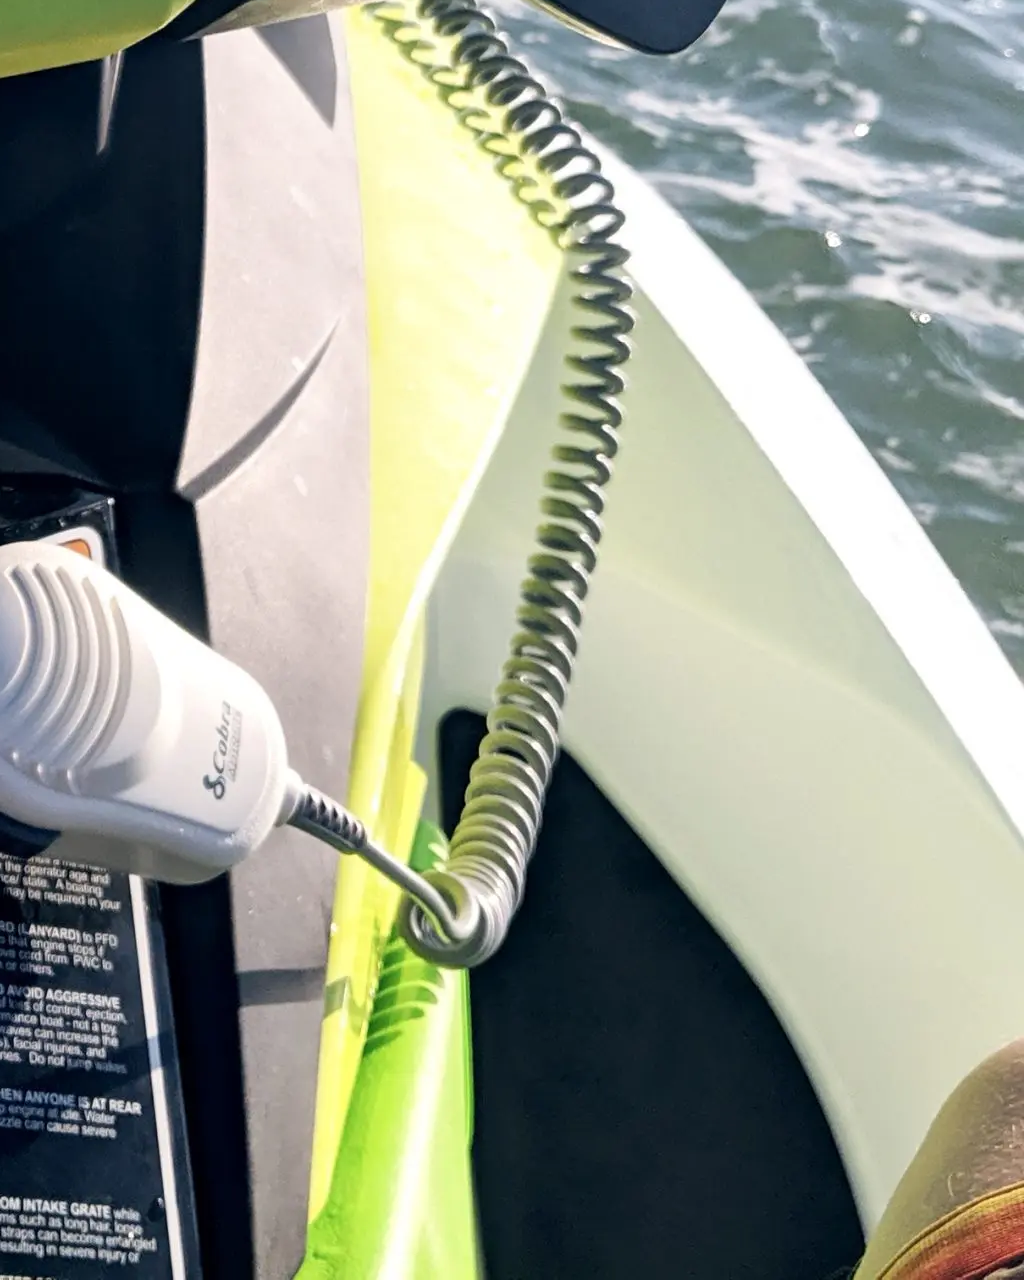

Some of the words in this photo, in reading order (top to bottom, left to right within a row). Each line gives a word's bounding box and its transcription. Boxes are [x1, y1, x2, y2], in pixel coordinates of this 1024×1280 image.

[5, 862, 22, 872] the
[24, 864, 67, 878] operator
[69, 871, 89, 882] age
[91, 872, 110, 885] and
[55, 879, 65, 889] A
[65, 881, 103, 898] boating
[27, 889, 42, 900] be
[44, 890, 85, 906] required
[88, 898, 97, 907] in
[99, 898, 121, 912] your
[18, 922, 81, 942] (LANYARD)
[83, 932, 93, 943] to
[95, 933, 118, 949] PFD
[30, 939, 65, 953] engine
[68, 944, 96, 957] stops
[44, 952, 69, 965] from
[73, 955, 100, 970] PWC
[102, 958, 114, 971] to
[7, 984, 44, 1000] AVOID
[45, 988, 121, 1009] AGGRESSIVE
[32, 1001, 44, 1012] of
[40, 1013, 64, 1028] boat
[72, 1018, 90, 1031] not
[92, 1022, 100, 1032] a
[13, 1036, 42, 1051] facial
[86, 1045, 107, 1058] and
[34, 1028, 55, 1039] can
[56, 1030, 101, 1045] increase
[102, 1035, 119, 1047] the
[29, 1052, 45, 1065] Do
[47, 1054, 65, 1067] not
[25, 1090, 76, 1107] ANYONE
[78, 1096, 90, 1108] IS
[91, 1097, 107, 1110] AT
[108, 1098, 143, 1115] REAR
[84, 1108, 116, 1124] Water
[47, 1121, 79, 1135] cause
[81, 1125, 117, 1140] severe
[23, 1198, 68, 1215] INTAKE
[70, 1202, 111, 1219] GRATE
[113, 1208, 140, 1222] while
[19, 1213, 46, 1227] such
[48, 1217, 62, 1228] as
[63, 1216, 88, 1233] long
[114, 1222, 143, 1236] loose
[0, 1226, 35, 1244] straps
[37, 1230, 59, 1242] can
[60, 1230, 105, 1246] become
[106, 1234, 157, 1252] entangled
[46, 1243, 58, 1256] in
[59, 1245, 96, 1260] severe
[97, 1248, 127, 1265] injury
[128, 1251, 140, 1264] or
